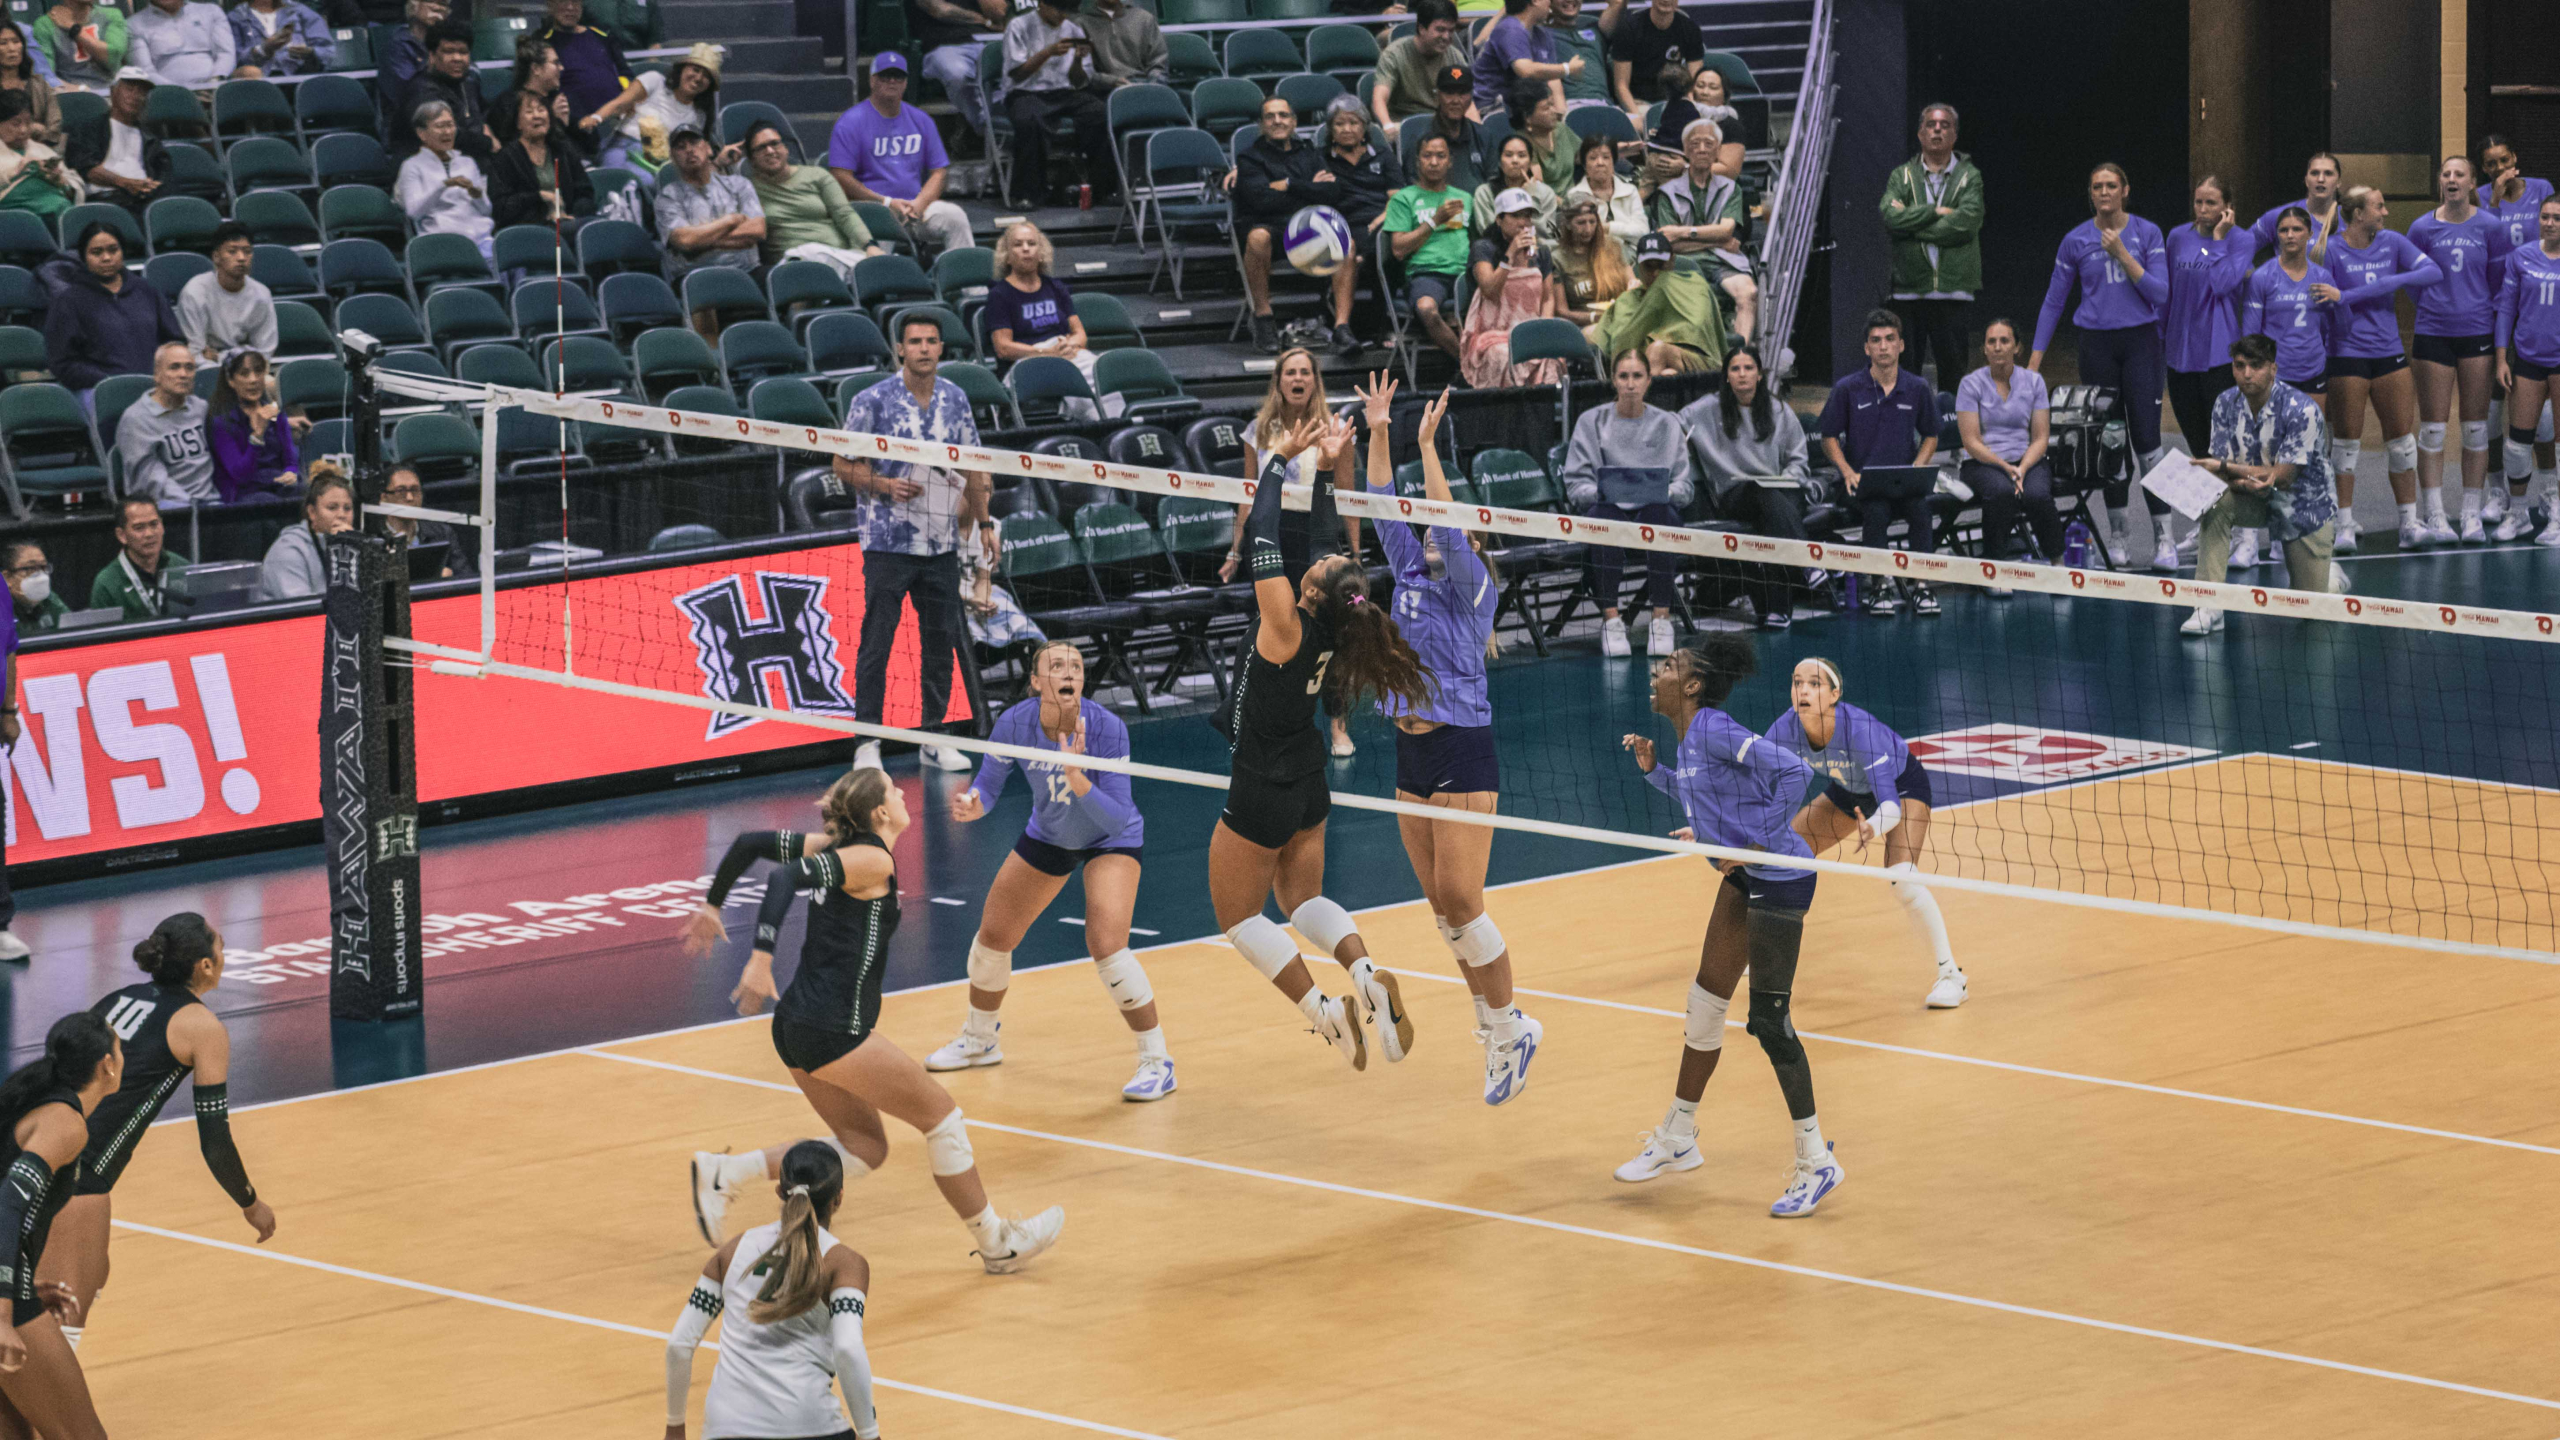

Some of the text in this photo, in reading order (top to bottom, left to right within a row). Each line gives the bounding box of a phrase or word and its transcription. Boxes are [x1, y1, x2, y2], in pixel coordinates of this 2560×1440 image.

[874, 133, 922, 157] USD
[2510, 223, 2524, 246] 6
[2346, 264, 2364, 273] SAN
[2451, 248, 2463, 272] 3
[2540, 281, 2555, 305] 11
[1022, 300, 1057, 319] USD
[2294, 303, 2307, 327] 2
[1137, 433, 1163, 457] H
[672, 570, 856, 742] H
[1306, 651, 1334, 694] 3
[1046, 774, 1073, 805] 12
[391, 878, 405, 930] sports
[221, 956, 331, 984] STA
[393, 931, 408, 995] imports
[105, 995, 157, 1041] 10
